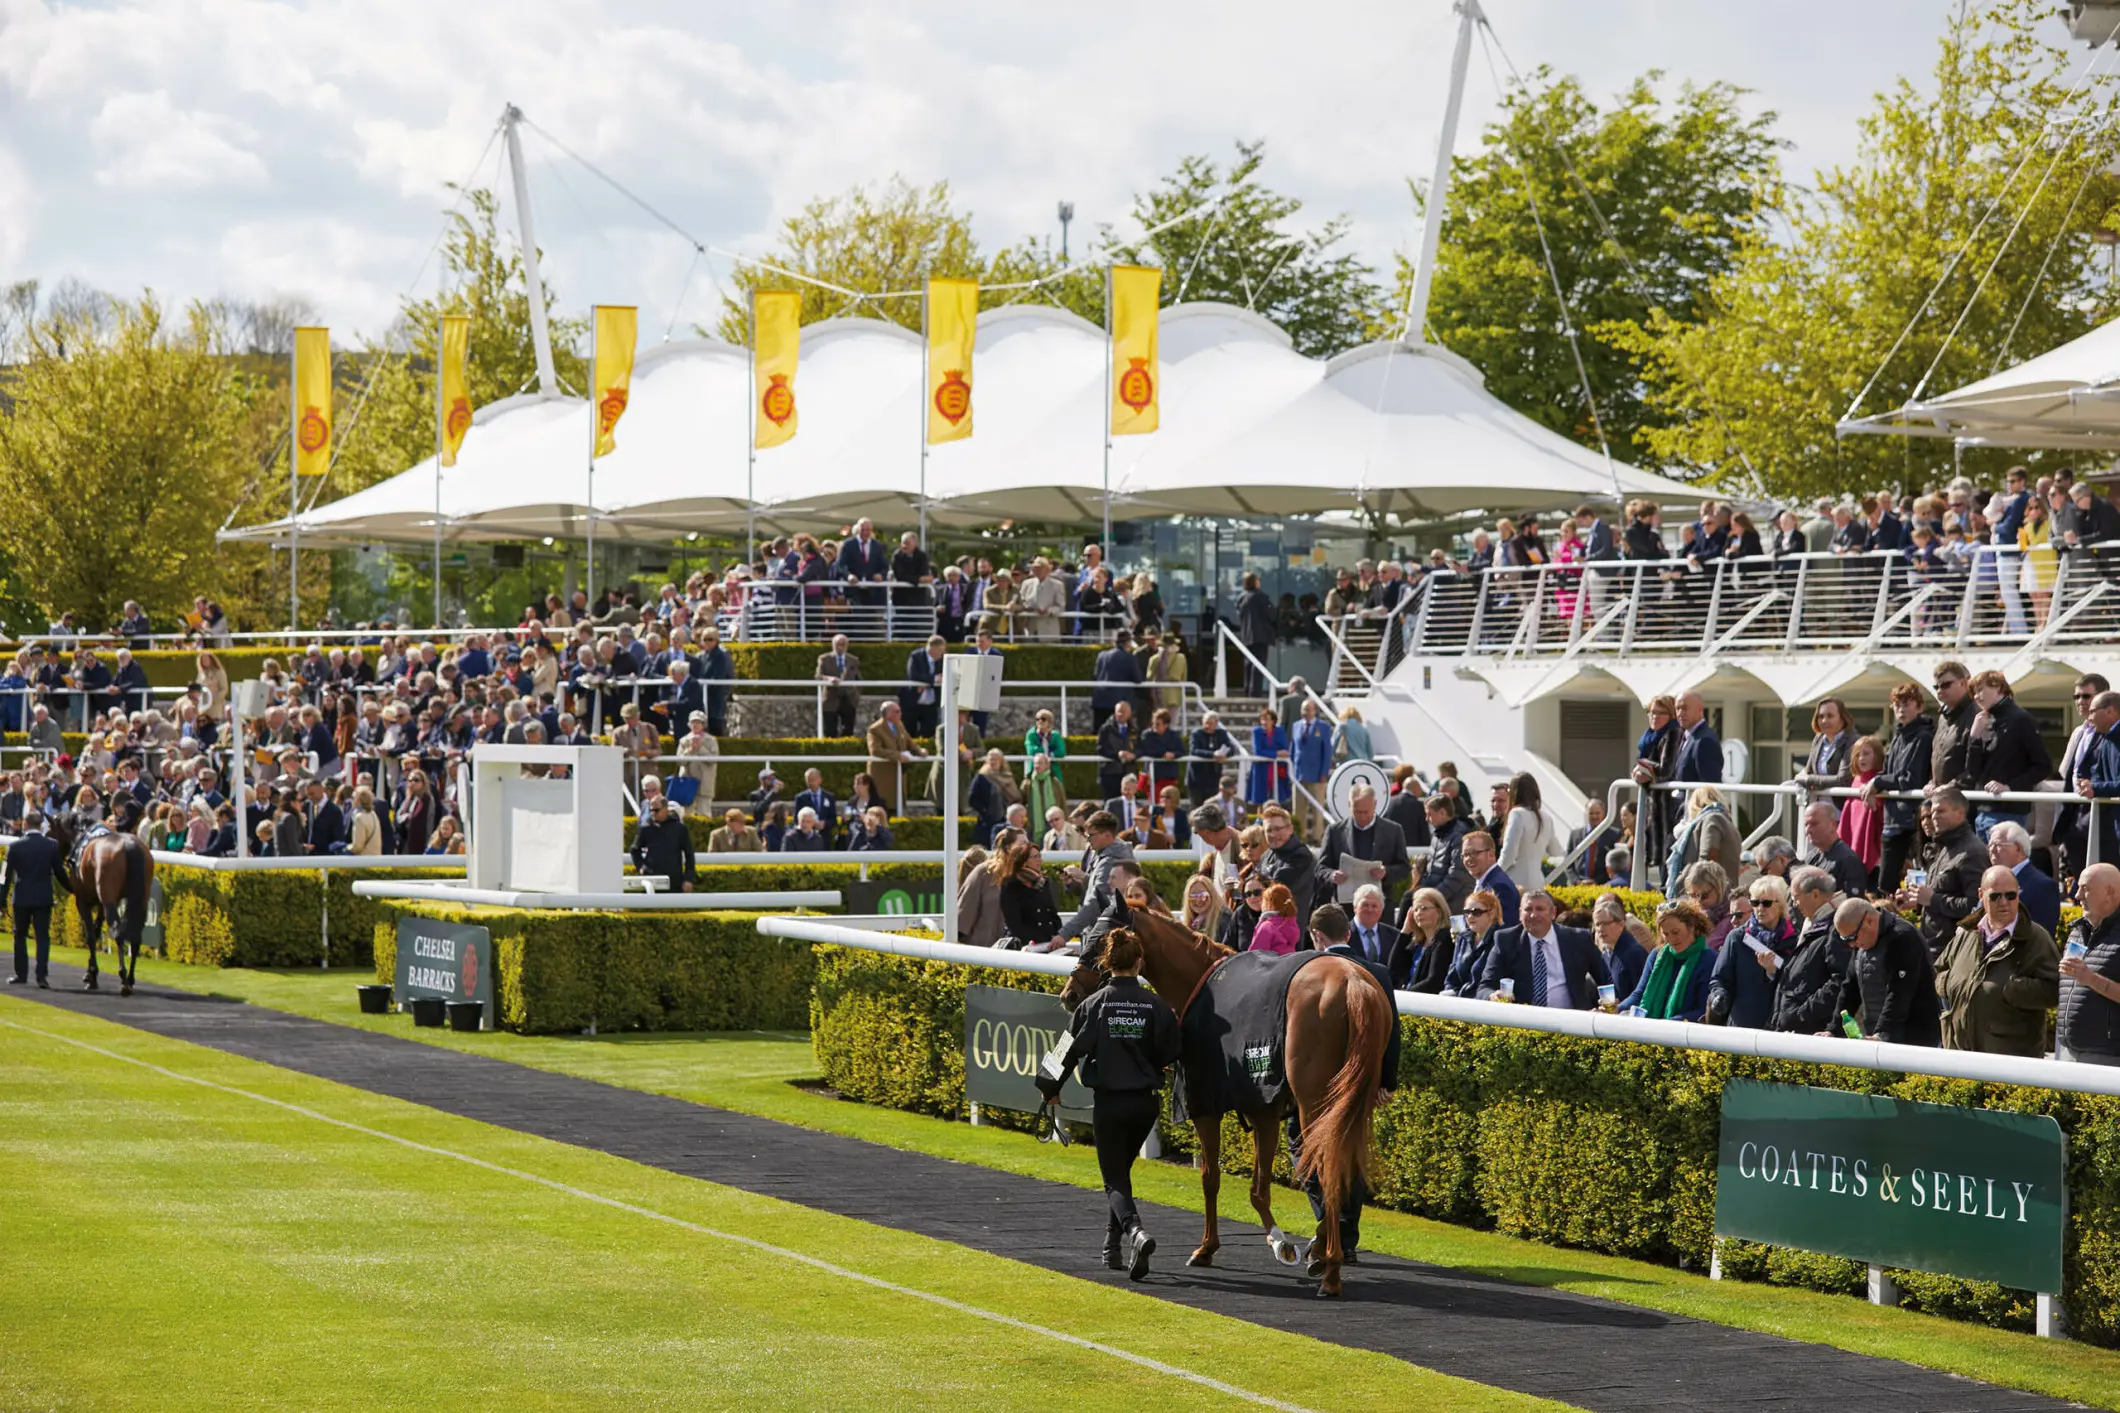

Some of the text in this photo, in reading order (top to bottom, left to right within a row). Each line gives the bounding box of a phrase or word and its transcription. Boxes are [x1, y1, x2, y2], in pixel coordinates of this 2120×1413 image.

[1728, 750, 1735, 777] 1
[414, 935, 455, 961] CHELSEA
[408, 965, 456, 994] BARRACKS
[1107, 1016, 1146, 1026] SIRECAM
[1109, 1025, 1144, 1034] EUROPE
[973, 1018, 1083, 1086] GOOD
[1739, 1141, 2034, 1222] COATES & SEELY
